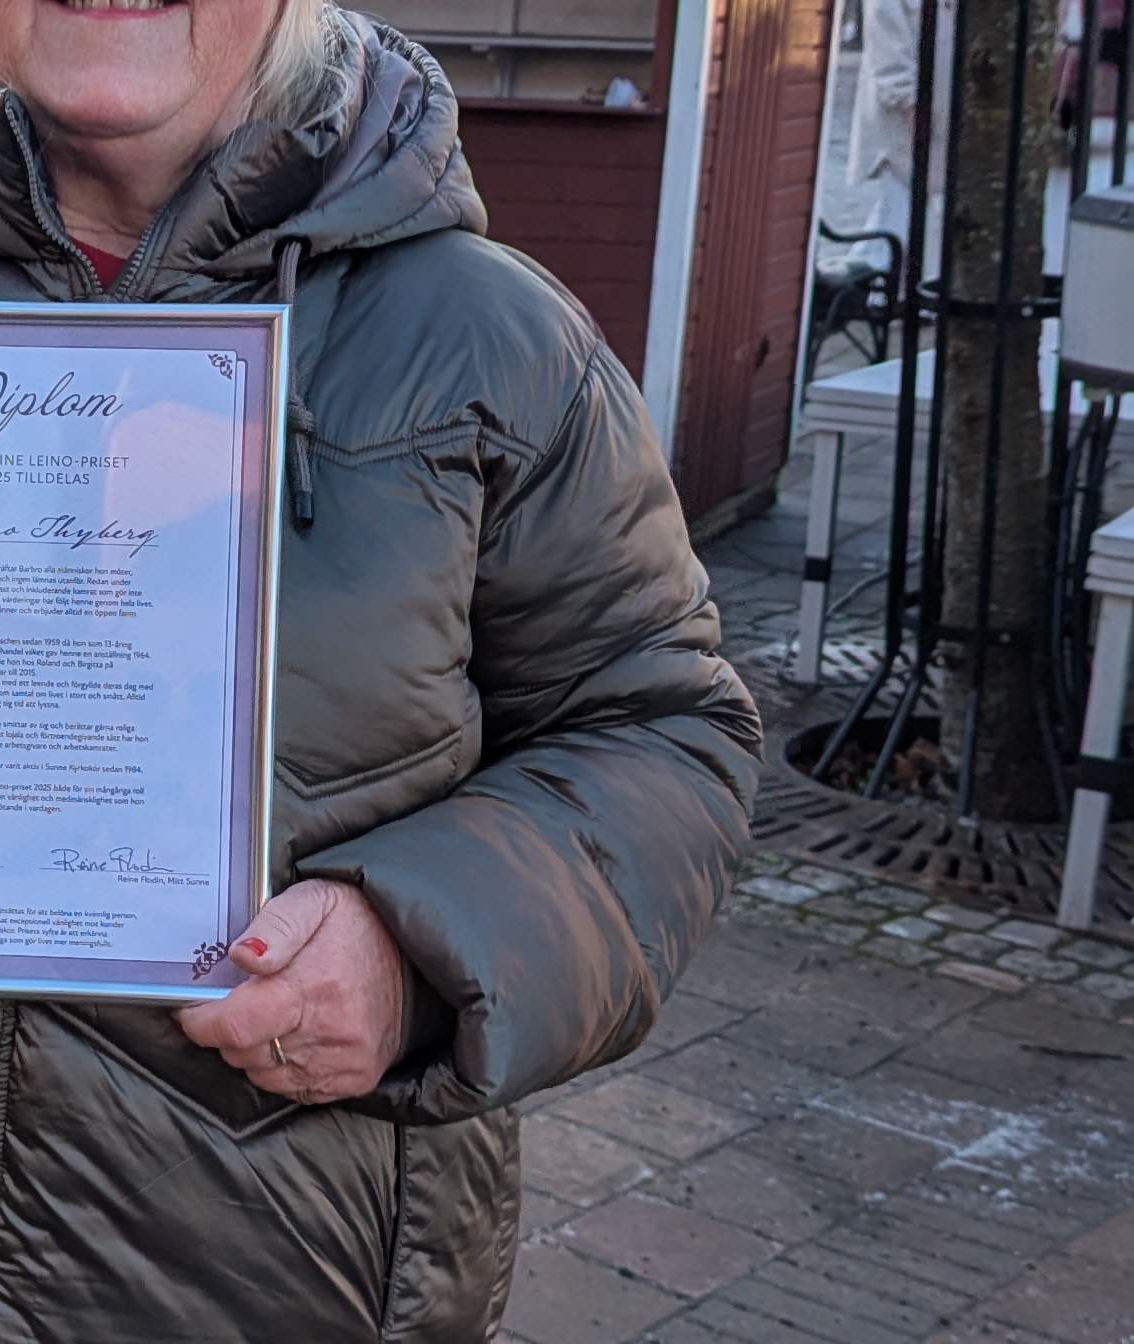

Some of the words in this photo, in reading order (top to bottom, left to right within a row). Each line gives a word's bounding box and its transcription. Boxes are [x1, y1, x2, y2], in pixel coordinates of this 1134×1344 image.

[29, 454, 130, 469] LEINO-PRISET
[17, 472, 90, 485] TILLDELAS
[30, 514, 158, 559] Thyberg
[19, 565, 42, 573] Barbro
[87, 576, 109, 584] Redan
[11, 585, 24, 593] och
[19, 606, 32, 614] och
[63, 659, 76, 667] och
[56, 679, 70, 687] och
[50, 721, 64, 729] och
[26, 731, 38, 739] och
[49, 742, 62, 750] och
[41, 793, 54, 801] och
